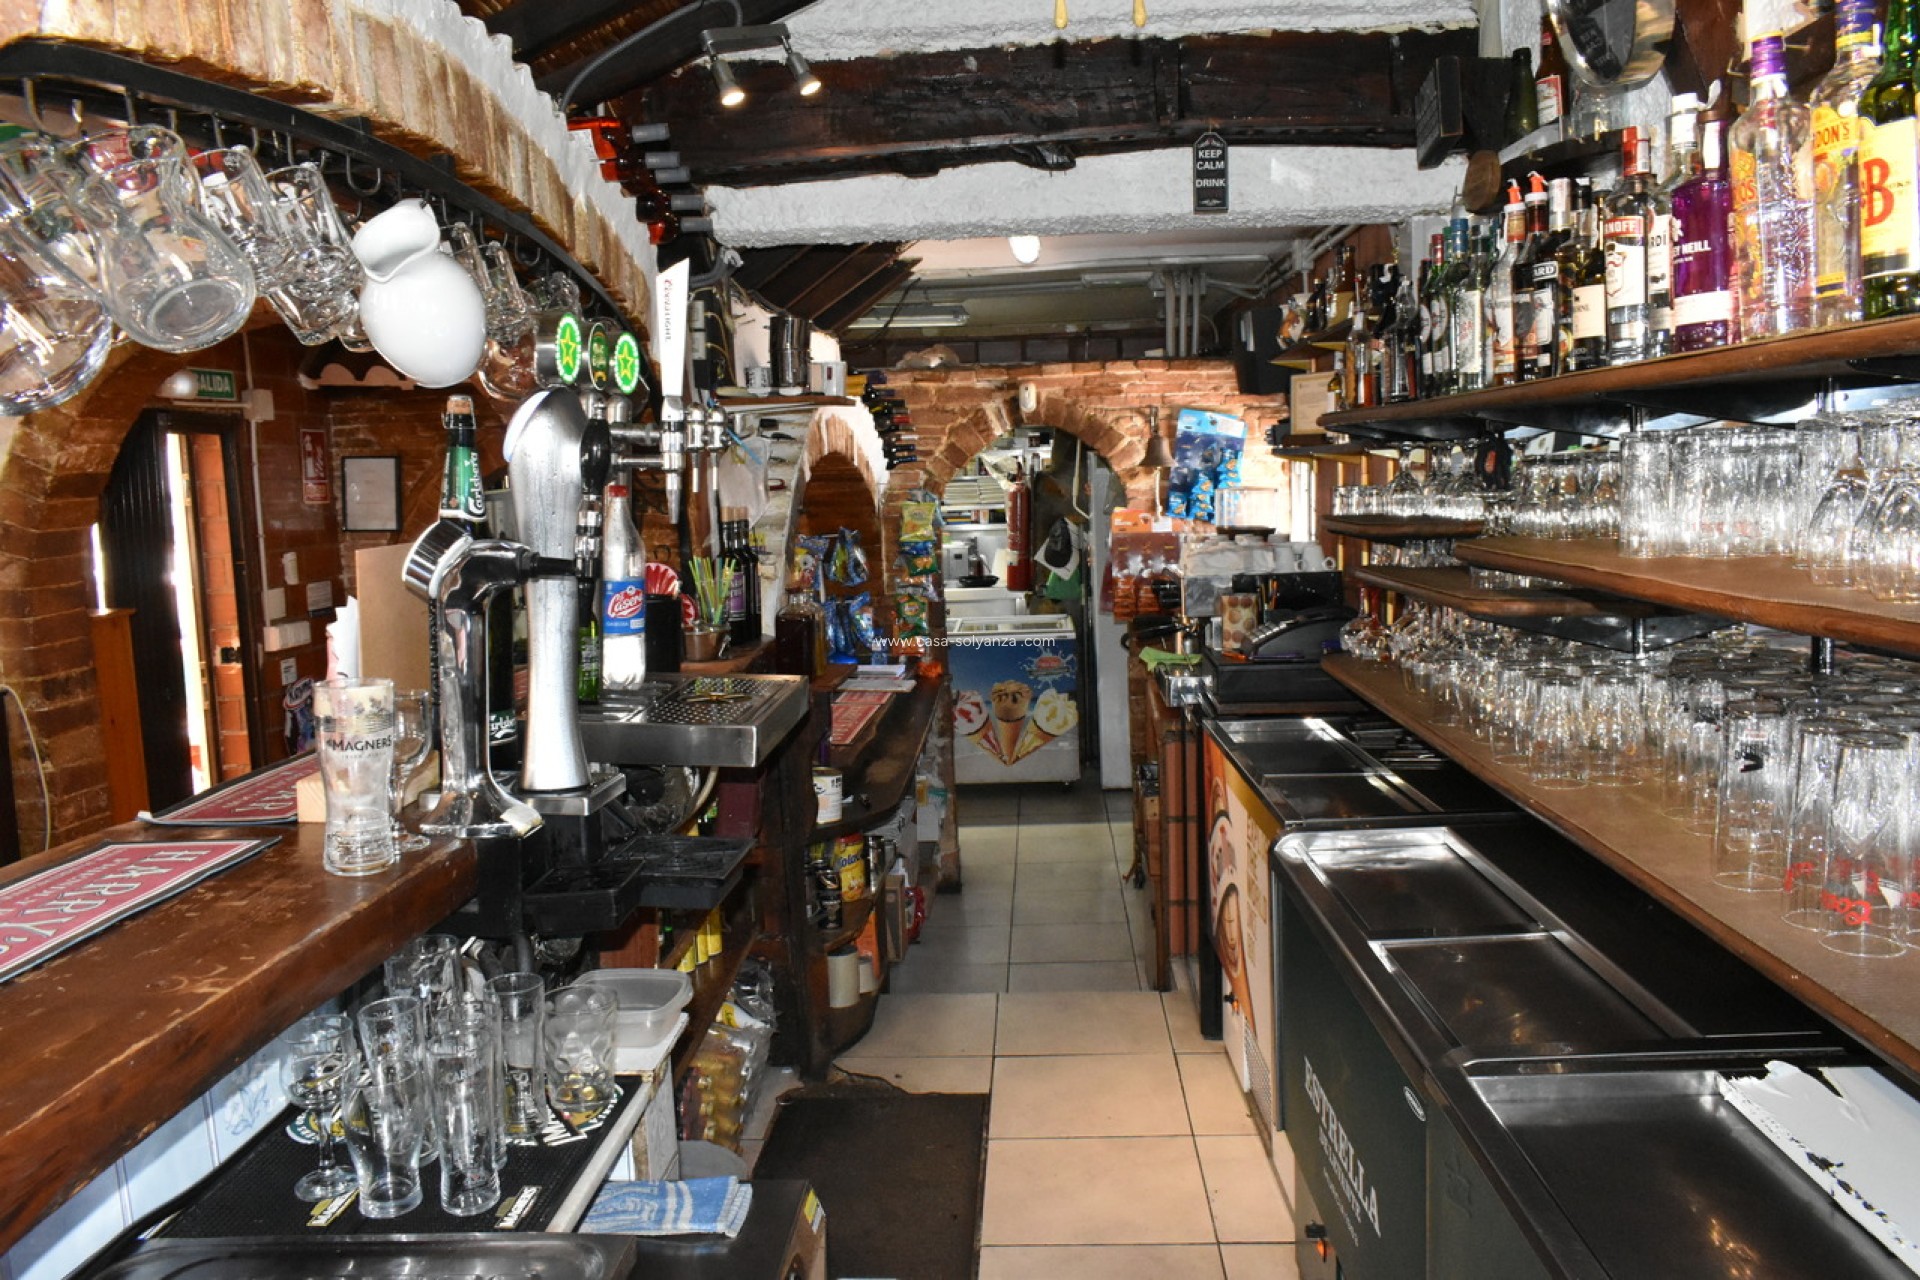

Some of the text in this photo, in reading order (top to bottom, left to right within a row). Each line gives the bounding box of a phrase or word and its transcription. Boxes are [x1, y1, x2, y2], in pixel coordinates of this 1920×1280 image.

[1198, 149, 1223, 158] KEEP
[1196, 161, 1225, 170] CALM
[1195, 178, 1226, 188] DRINK
[467, 452, 485, 515] Carlsberg
[332, 734, 392, 752] MAGNERS
[1303, 1055, 1382, 1239] ESTRELLA
